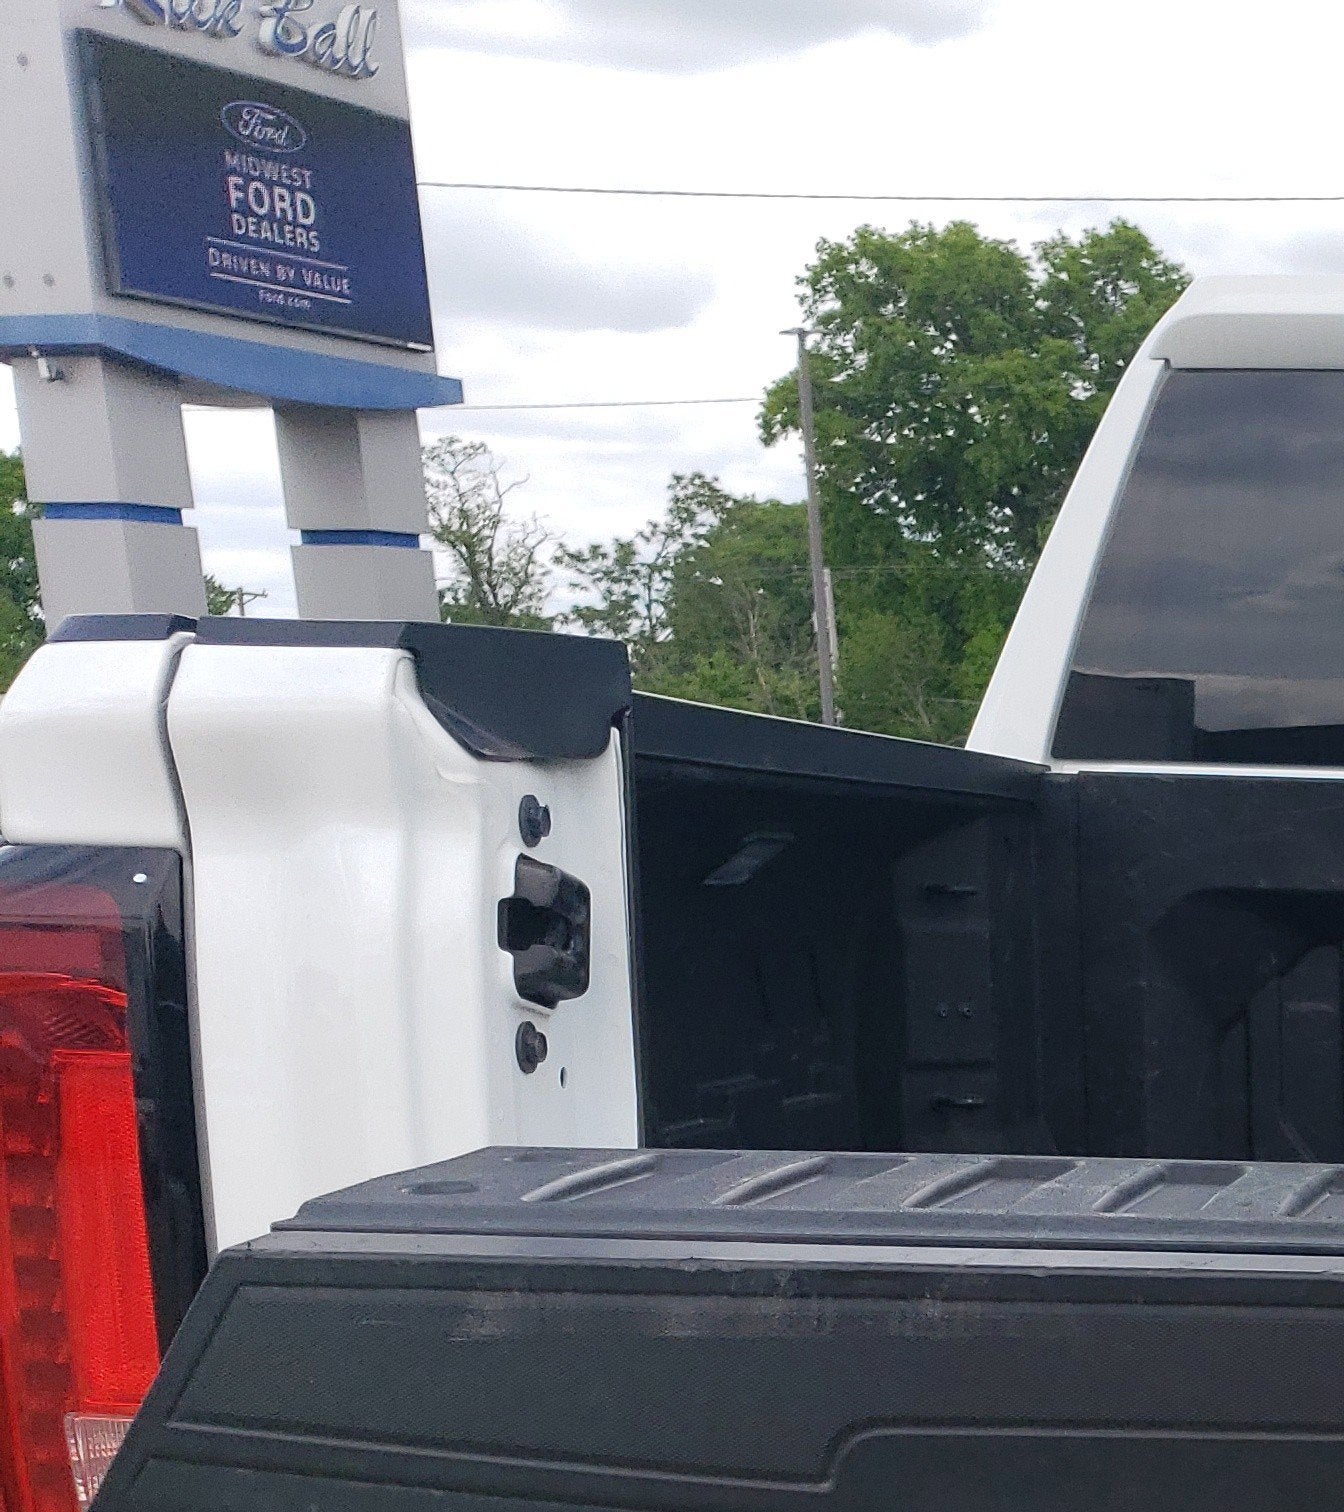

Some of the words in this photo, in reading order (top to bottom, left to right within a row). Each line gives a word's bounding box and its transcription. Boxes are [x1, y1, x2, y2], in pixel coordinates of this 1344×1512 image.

[238, 108, 289, 146] Ford
[225, 150, 313, 189] MIDWEST
[226, 175, 316, 226] FORD
[231, 213, 320, 252] DEALERS
[208, 247, 271, 277] DRIVEN
[276, 264, 295, 282] BY
[302, 268, 350, 294] VALUE
